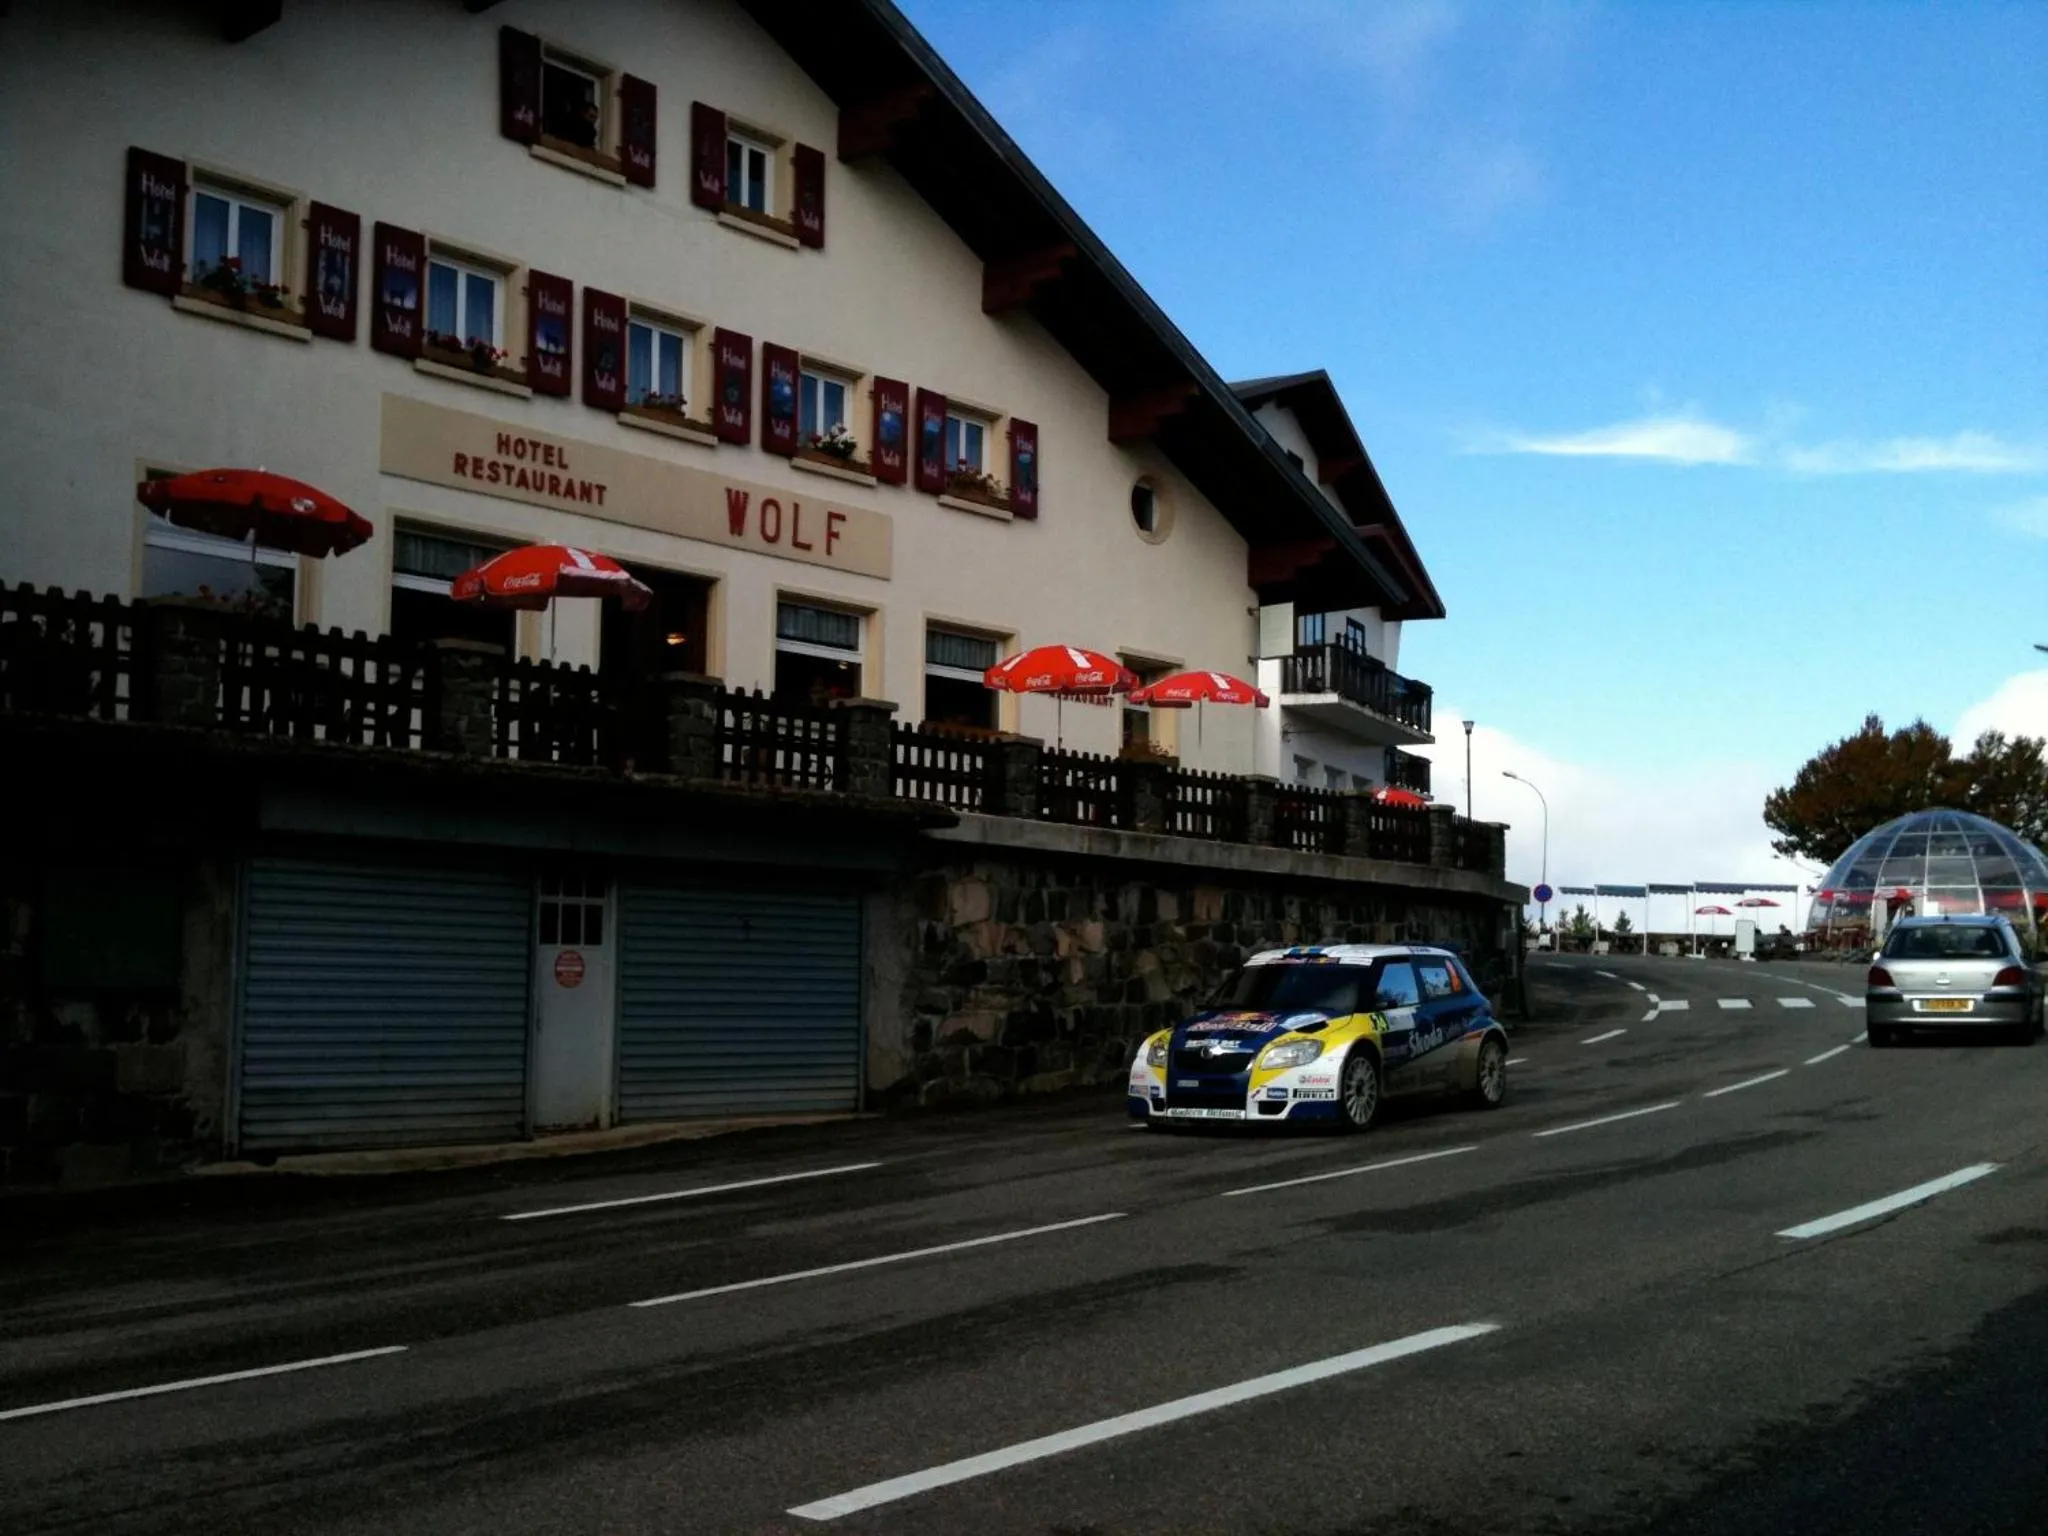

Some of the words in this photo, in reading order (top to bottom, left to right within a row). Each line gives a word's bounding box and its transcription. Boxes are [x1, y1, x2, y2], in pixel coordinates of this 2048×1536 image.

[140, 170, 176, 200] Hotel
[320, 223, 351, 252] Hotel
[386, 244, 417, 272] Hotel
[318, 292, 347, 319] Wolf
[538, 290, 566, 316] Hotel
[496, 432, 569, 470] HOTEL
[453, 452, 608, 506] RESTAURANT
[726, 487, 847, 555] WOLF
[1293, 1088, 1335, 1099] PIRELLI
